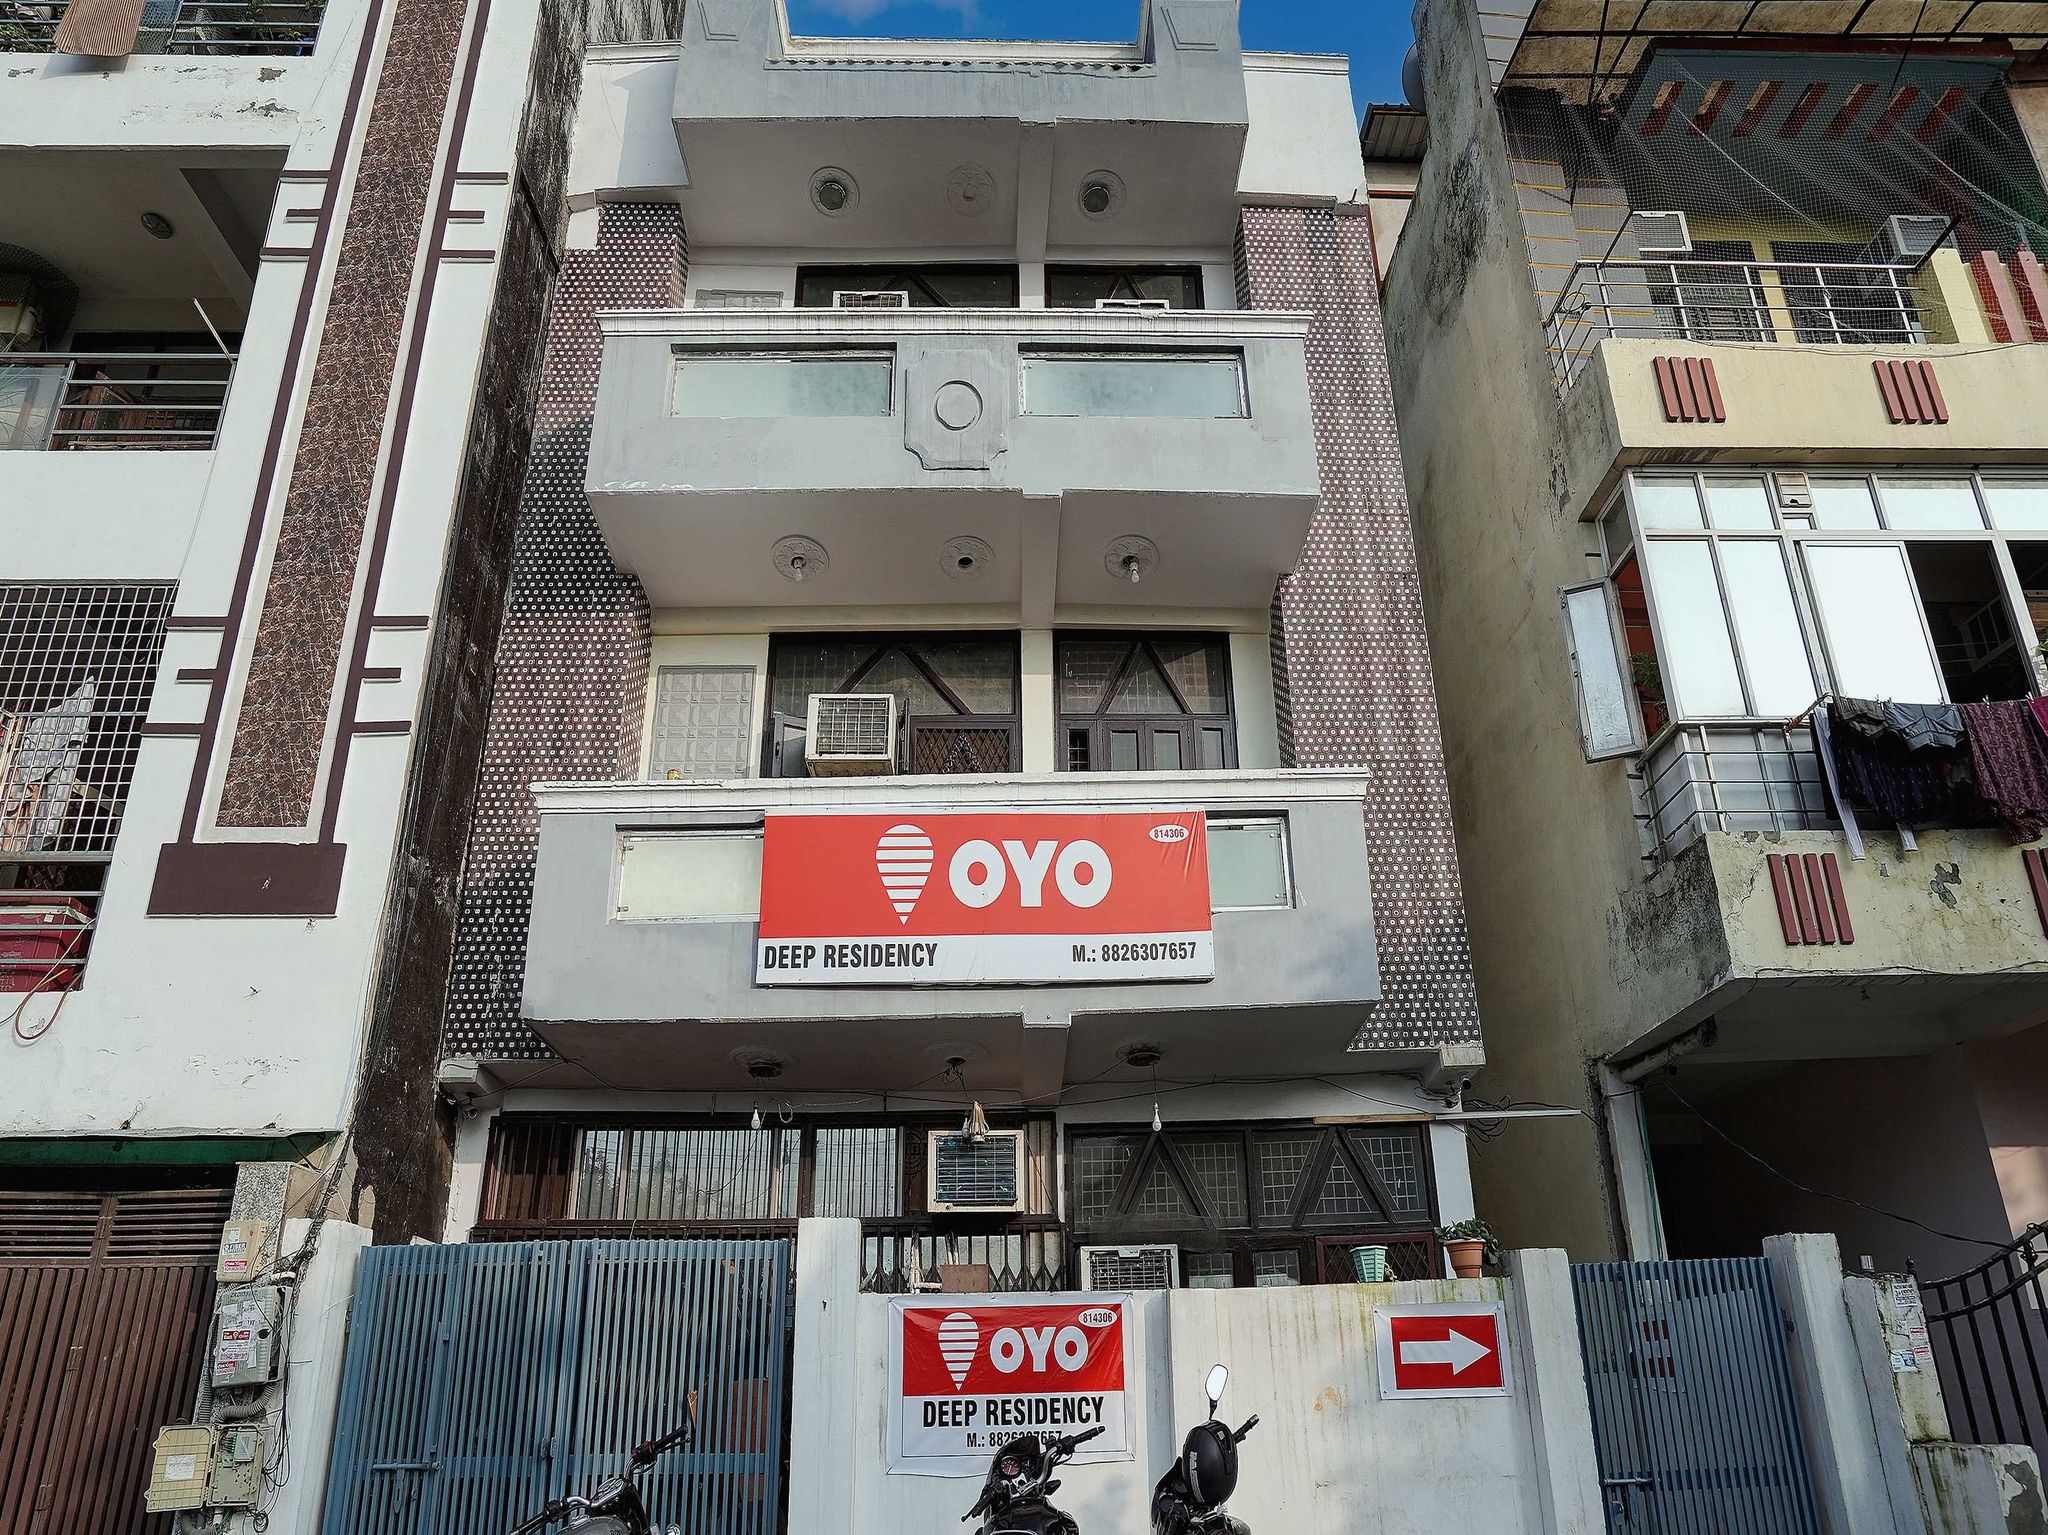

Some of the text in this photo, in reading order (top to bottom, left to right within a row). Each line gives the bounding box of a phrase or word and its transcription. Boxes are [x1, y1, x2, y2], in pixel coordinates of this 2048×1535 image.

[1153, 827, 1185, 840] 814306
[949, 839, 1113, 908] OYO
[764, 943, 938, 969] DEEP RESIDENCY
[1072, 942, 1197, 963] M.: 8826307657
[1082, 1312, 1113, 1323] 814306
[989, 1325, 1089, 1374] OYO
[923, 1396, 1104, 1428] DEEP RESIDENCY
[967, 1433, 985, 1448] M.:
